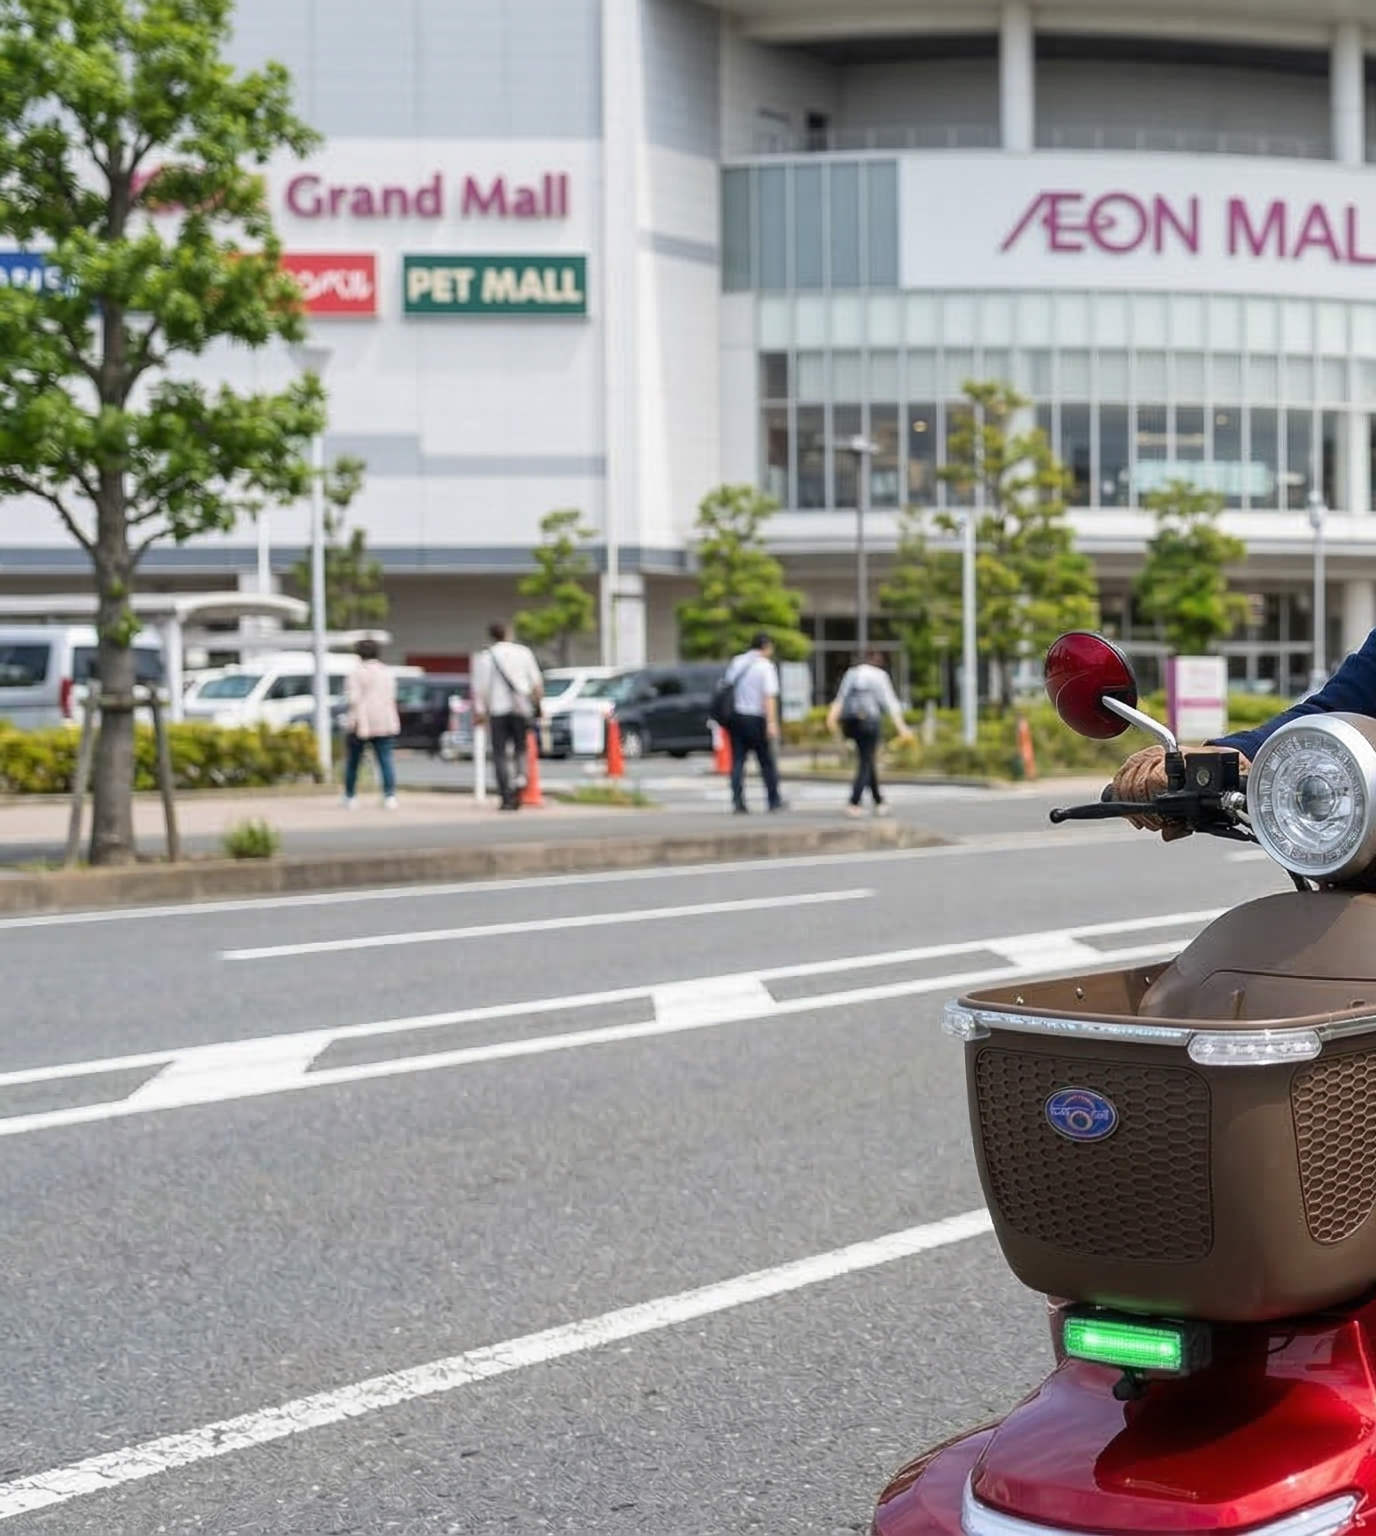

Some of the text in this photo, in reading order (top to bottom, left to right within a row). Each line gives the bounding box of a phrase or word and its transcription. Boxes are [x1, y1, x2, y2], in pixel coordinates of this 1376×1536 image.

[286, 171, 443, 220] Grand
[461, 172, 569, 220] Mall
[407, 266, 584, 304] PET MALL
